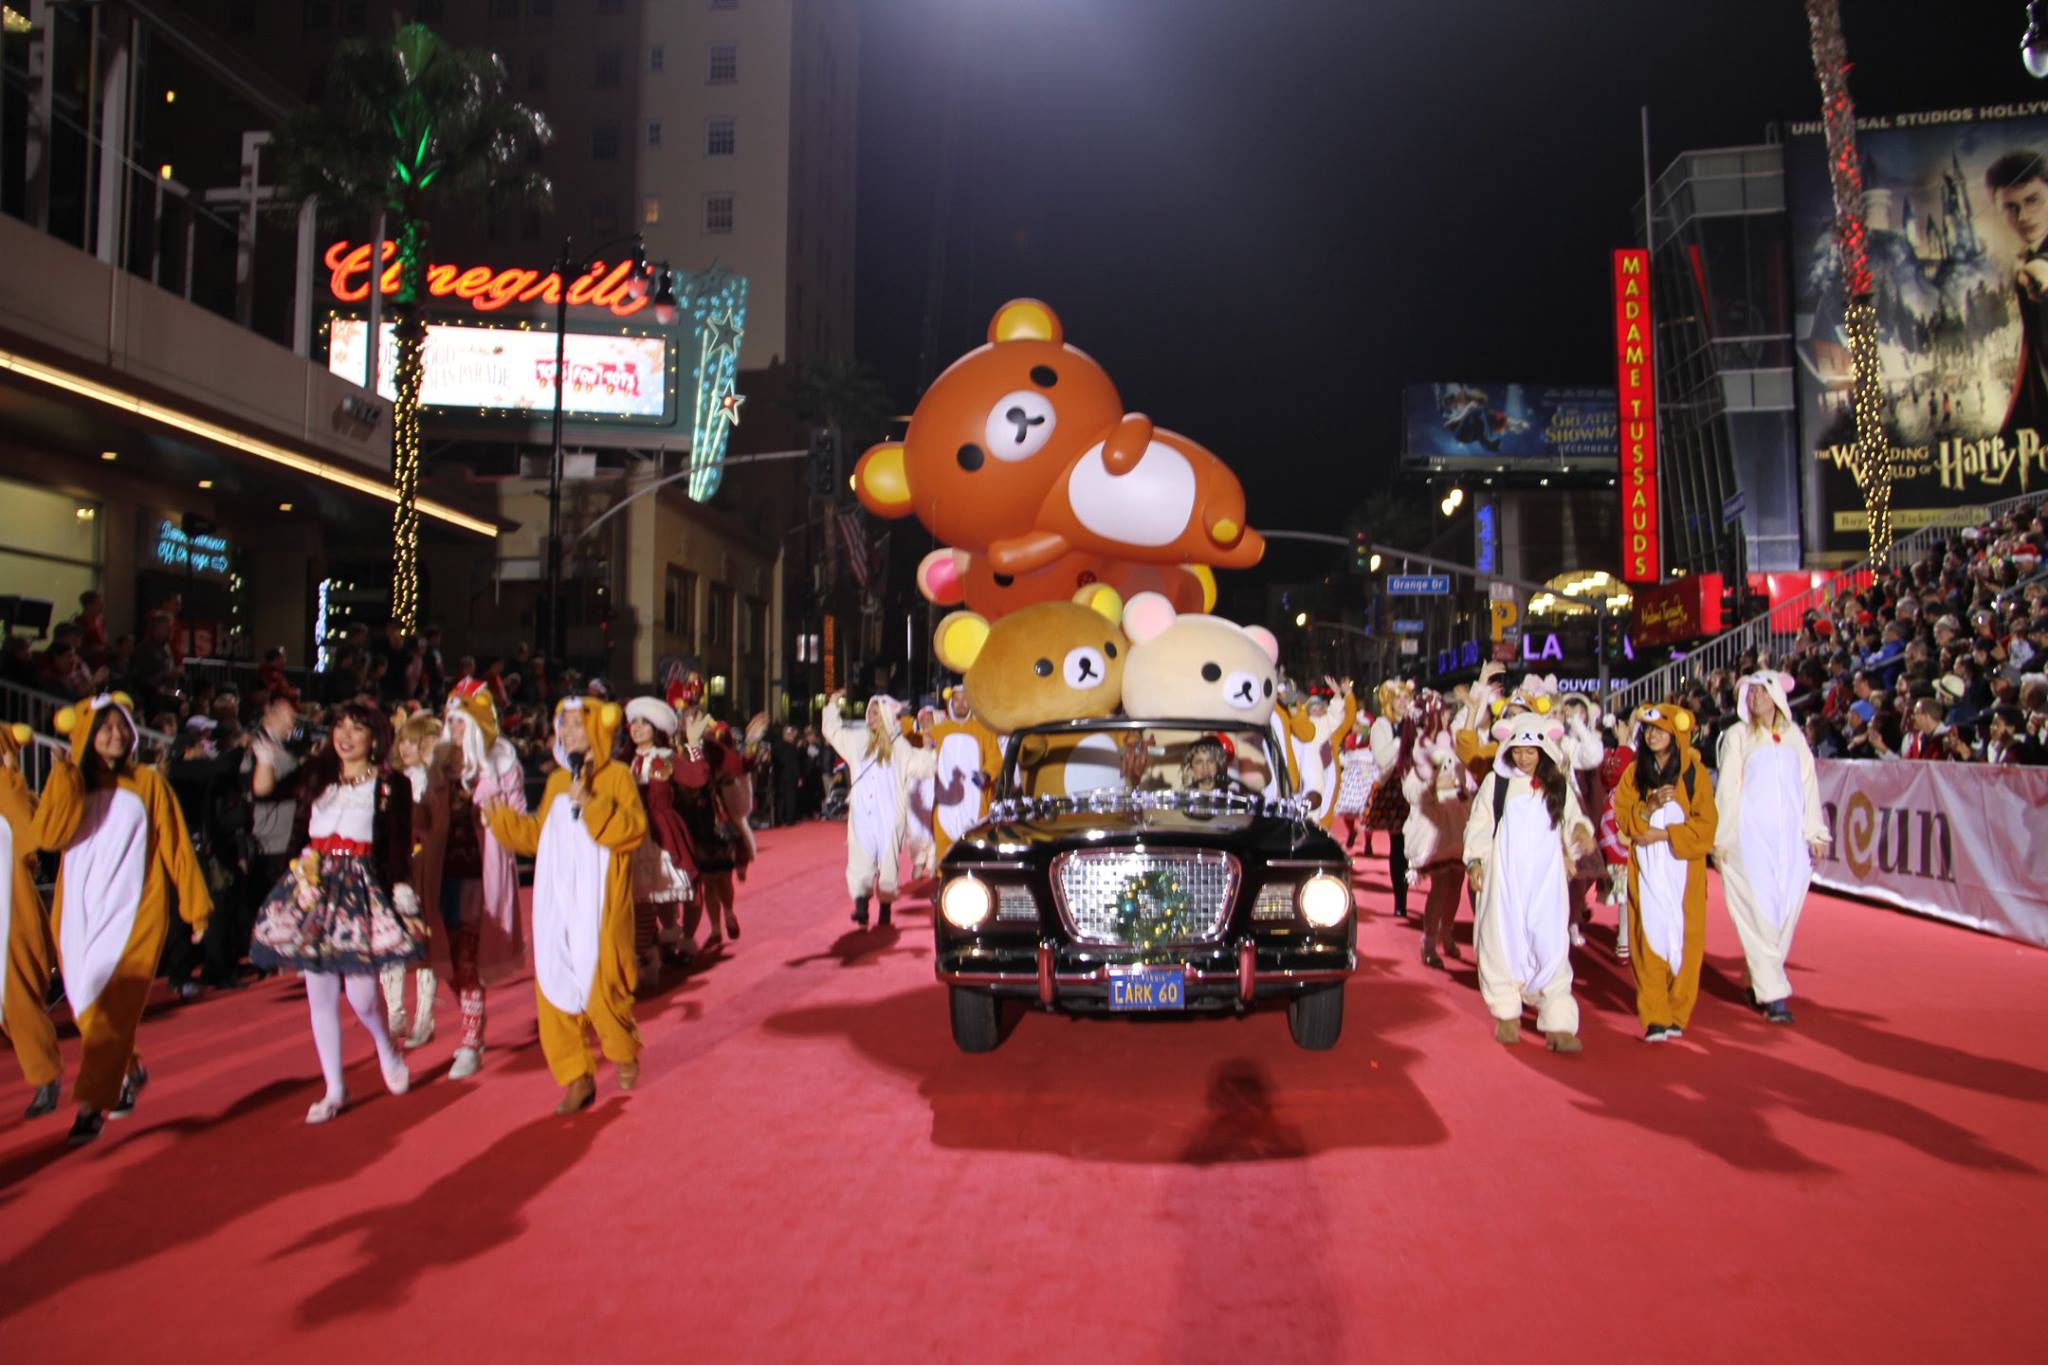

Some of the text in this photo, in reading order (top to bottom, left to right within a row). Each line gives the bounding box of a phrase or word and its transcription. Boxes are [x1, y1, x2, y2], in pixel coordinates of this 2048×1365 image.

[1792, 113, 1890, 134] UNISAL
[1896, 107, 1973, 126] STUDIOS
[1622, 256, 1644, 388] MADAME
[1934, 435, 2017, 490] Harry
[1629, 400, 1648, 577] TUSSAUDS
[1393, 579, 1443, 591] Orange Dr
[1523, 634, 1563, 660] LA
[1159, 982, 1178, 1003] 60
